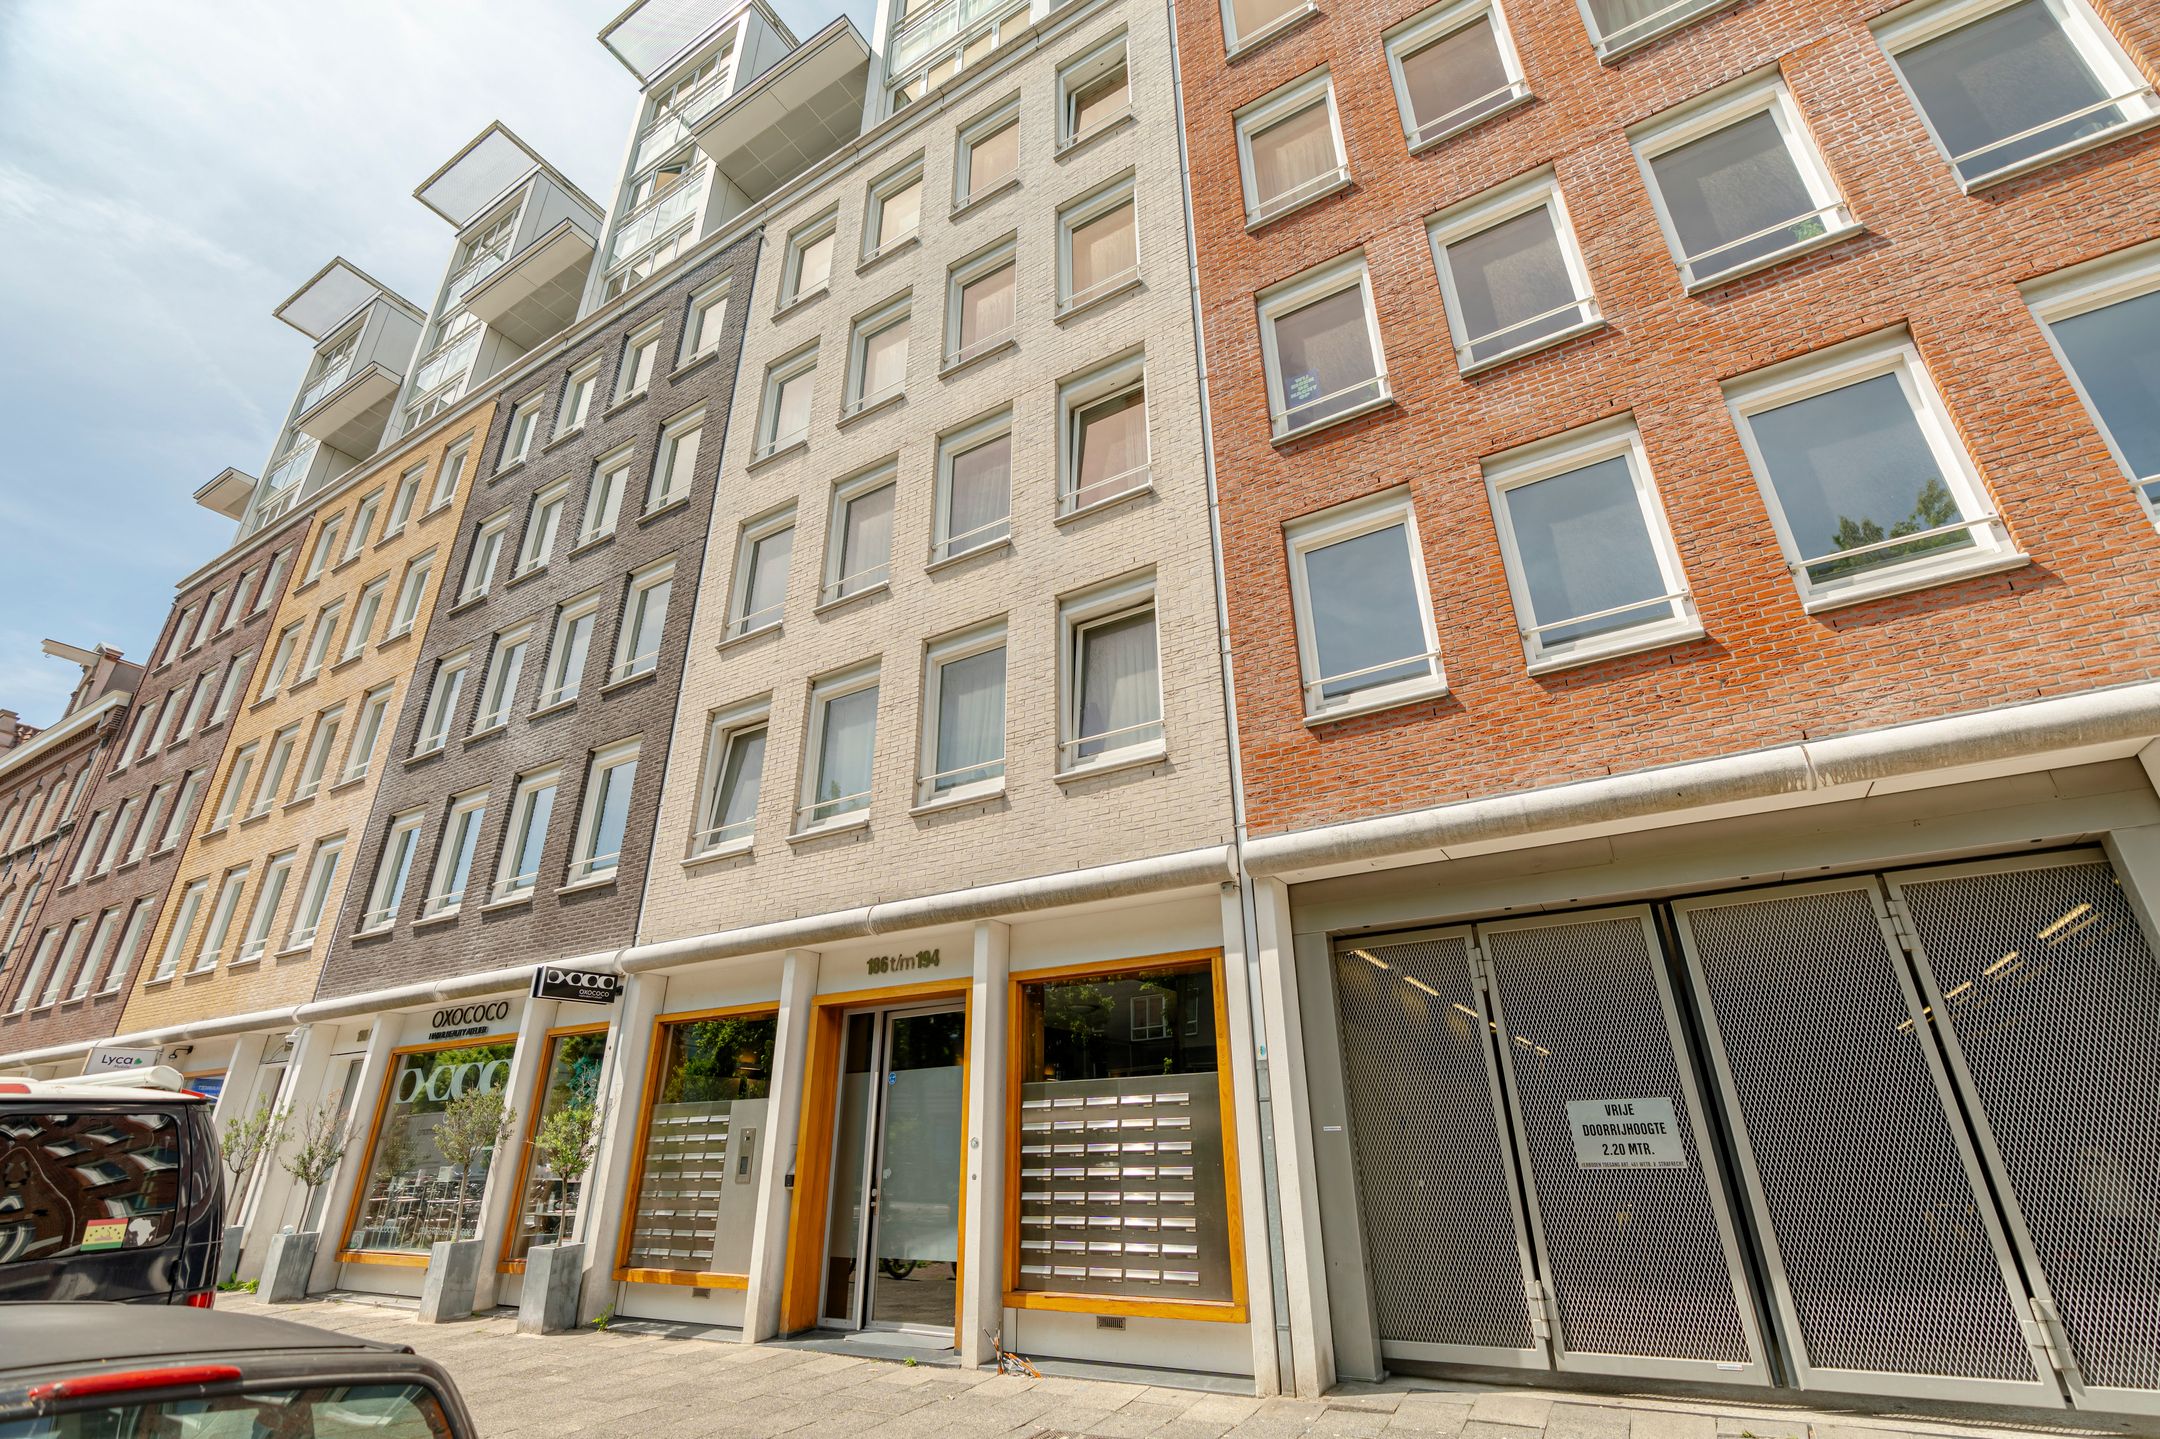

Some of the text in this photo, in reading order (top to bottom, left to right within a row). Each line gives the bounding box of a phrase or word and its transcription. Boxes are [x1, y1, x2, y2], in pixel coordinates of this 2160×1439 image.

[866, 948, 940, 975] 186 t/m 194
[579, 988, 610, 998] OXOCOCO
[432, 1001, 509, 1028] OXOCOCO
[101, 1054, 133, 1065] Lyca
[1604, 1103, 1635, 1117] VRIJE
[1582, 1122, 1667, 1137] DOORRIJHOOGTE
[1602, 1142, 1655, 1156] 2.20 MTR.
